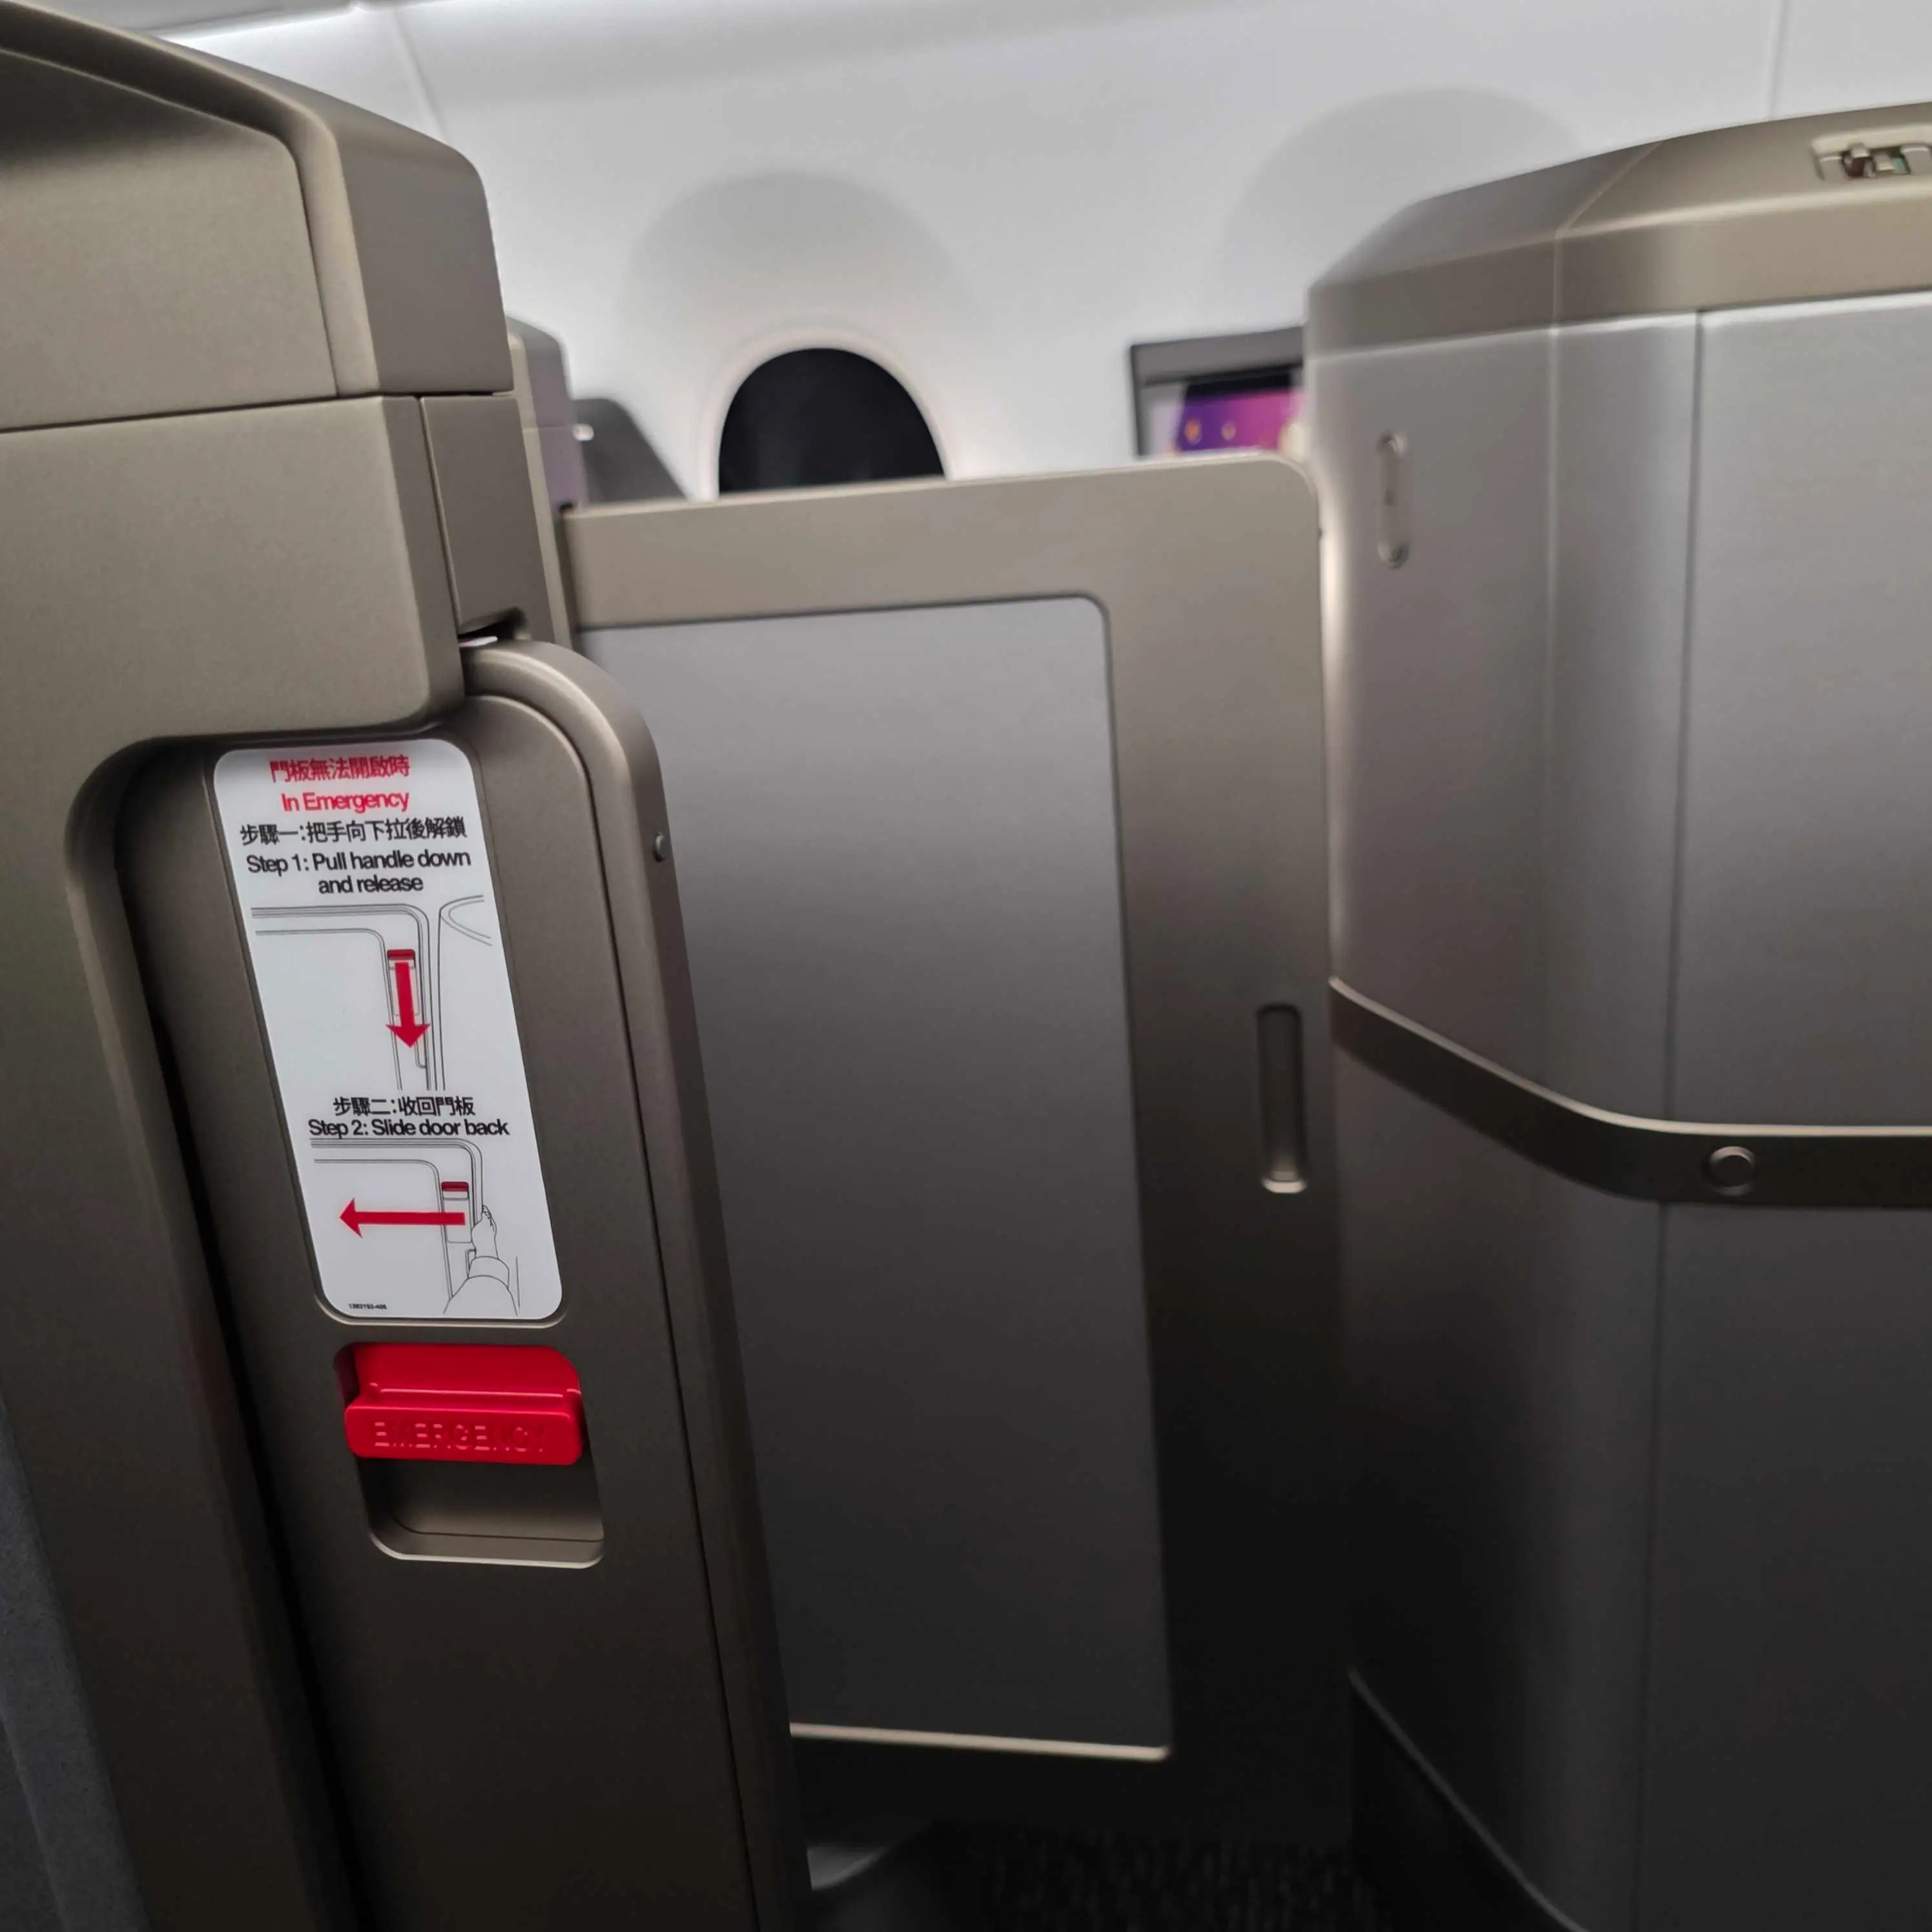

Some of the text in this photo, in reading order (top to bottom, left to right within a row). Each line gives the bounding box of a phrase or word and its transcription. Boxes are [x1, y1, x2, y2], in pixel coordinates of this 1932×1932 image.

[282, 792, 410, 814] In Emergency
[247, 848, 471, 877] Step 1: Pull handle down
[318, 874, 424, 894] and release
[308, 1119, 510, 1139] Step 2: Slide door back
[374, 1421, 546, 1453] EMERGENCY
